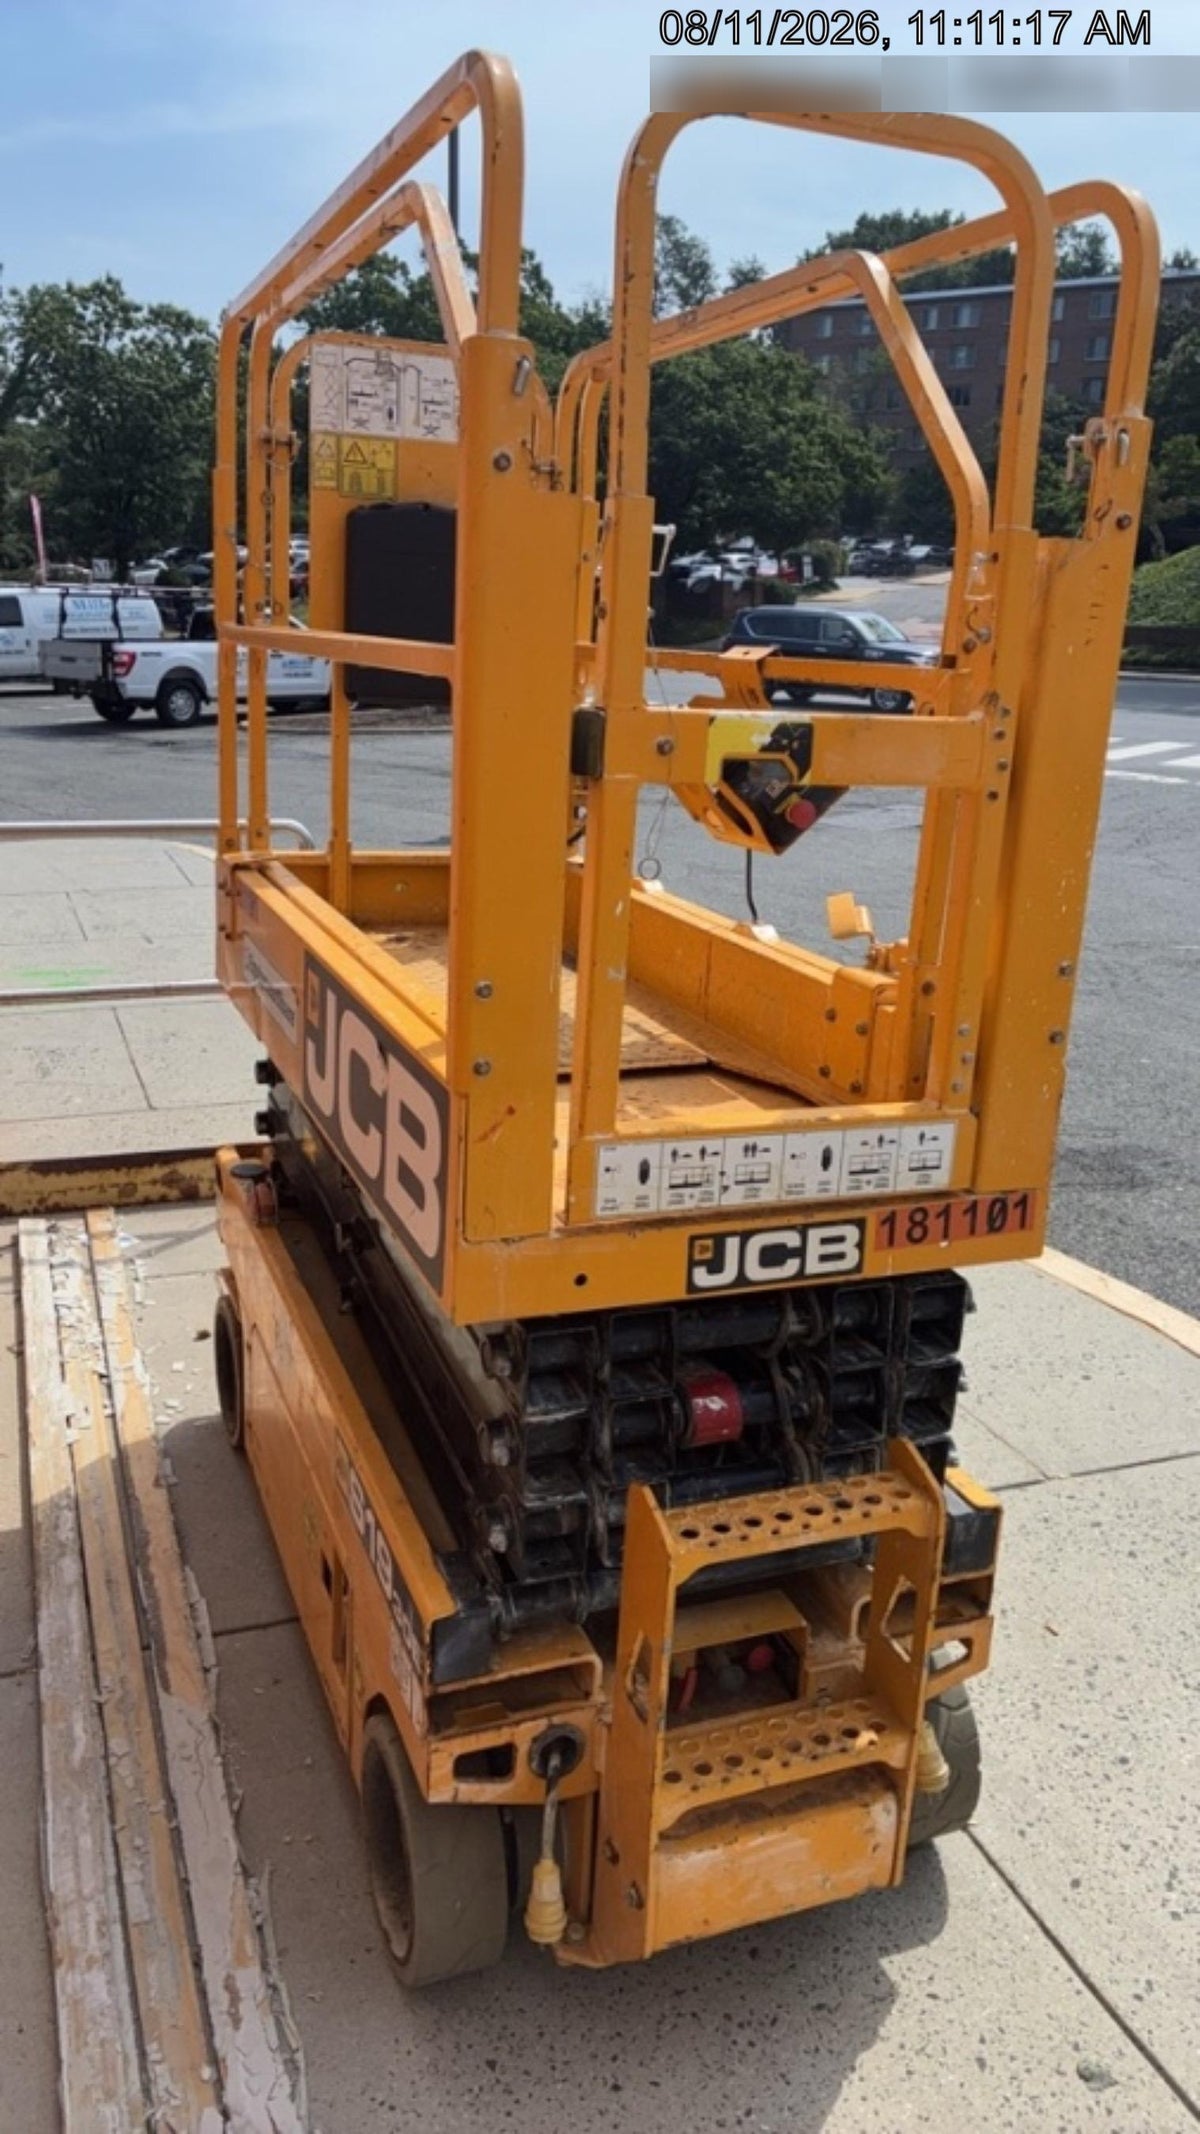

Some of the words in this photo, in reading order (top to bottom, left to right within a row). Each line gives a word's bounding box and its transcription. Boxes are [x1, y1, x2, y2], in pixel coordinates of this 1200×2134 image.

[306, 986, 443, 1259] JCB
[880, 1192, 1029, 1248] 181101
[692, 1224, 862, 1289] JCB
